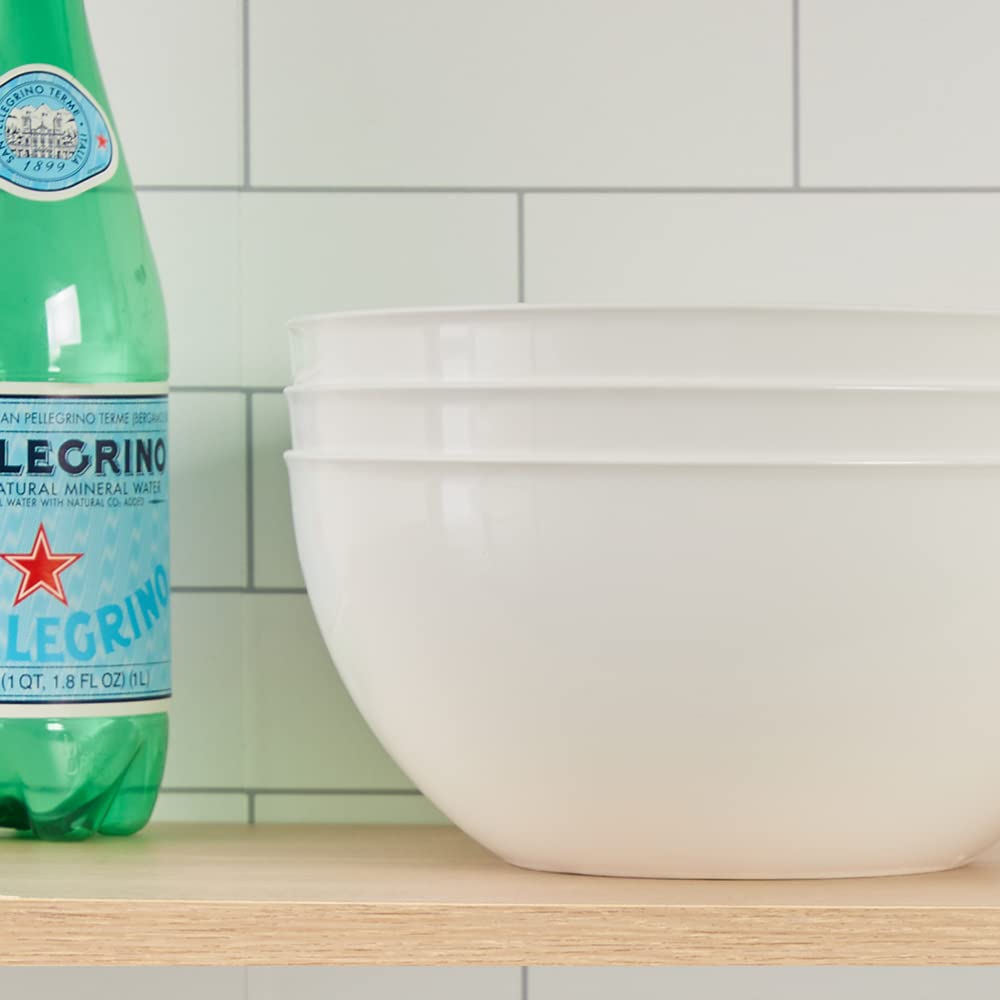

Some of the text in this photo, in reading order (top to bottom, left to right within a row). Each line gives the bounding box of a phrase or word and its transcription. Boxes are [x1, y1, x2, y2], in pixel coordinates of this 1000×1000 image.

[50, 88, 80, 116] TERME
[23, 160, 65, 172] 1899
[25, 412, 96, 425] PELLEGRINO
[100, 413, 129, 425] TERME
[0, 437, 167, 476] LEGRINO
[65, 482, 128, 496] MINERAL
[133, 480, 161, 495] WATER
[7, 497, 37, 507] WATER
[40, 498, 64, 507] WITH
[67, 498, 105, 508] NATURAL
[6, 563, 169, 664] LEGRINO
[54, 675, 75, 689] 1.8
